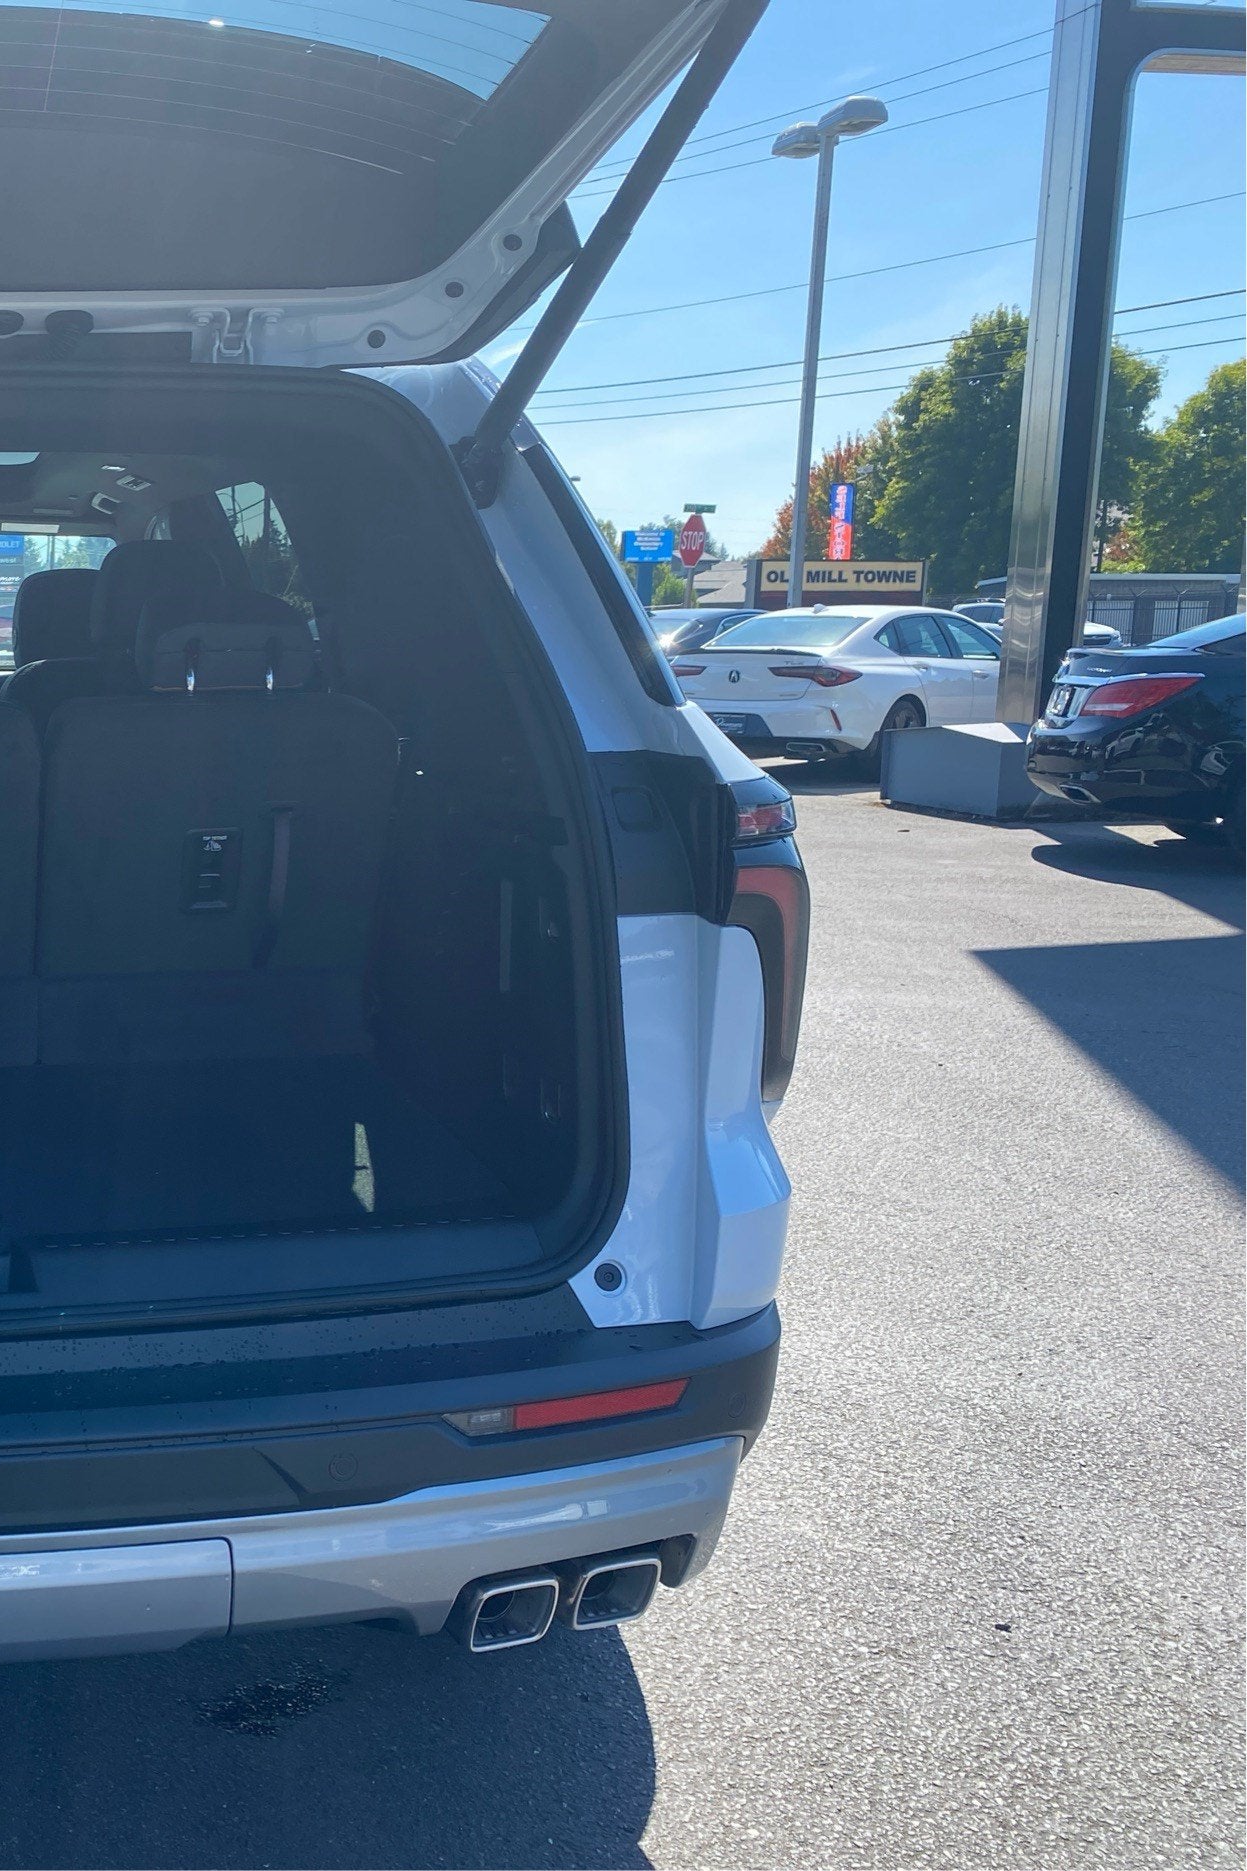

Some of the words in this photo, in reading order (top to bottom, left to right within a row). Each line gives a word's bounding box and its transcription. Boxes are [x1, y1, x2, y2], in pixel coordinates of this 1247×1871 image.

[680, 530, 705, 551] STOP
[766, 570, 790, 583] OL
[806, 570, 848, 583] MILL
[853, 570, 916, 583] TOWNE
